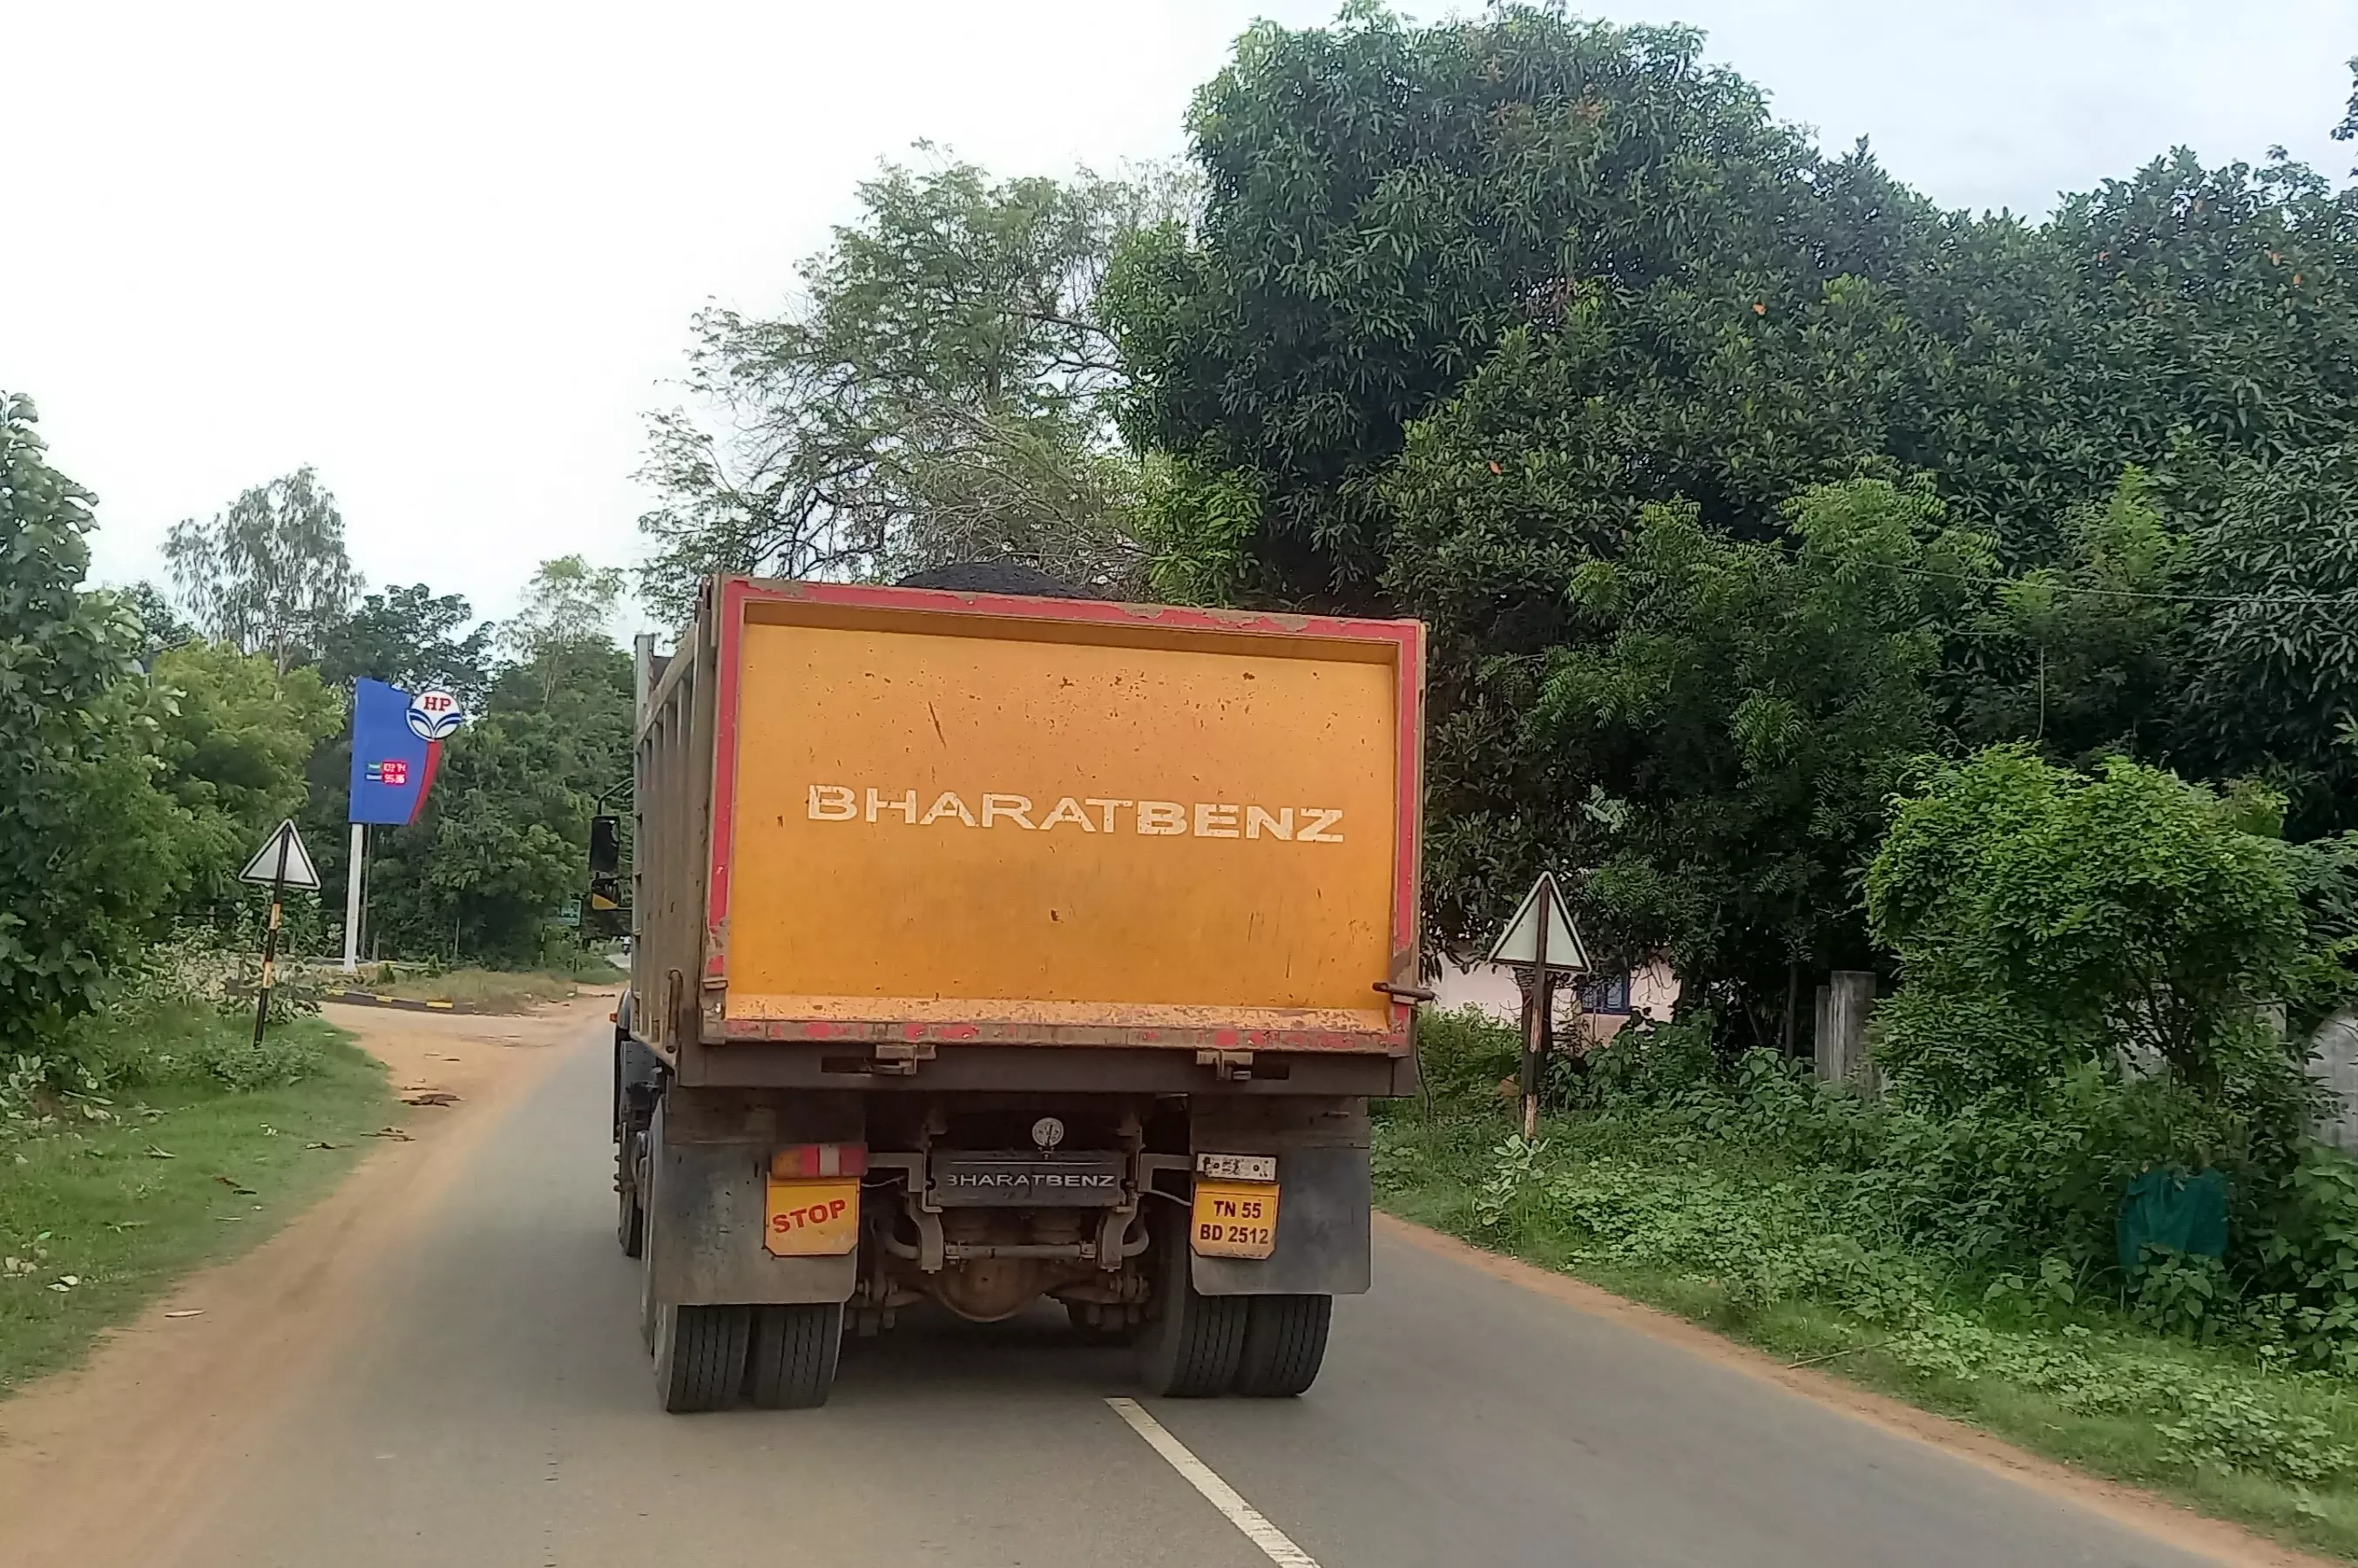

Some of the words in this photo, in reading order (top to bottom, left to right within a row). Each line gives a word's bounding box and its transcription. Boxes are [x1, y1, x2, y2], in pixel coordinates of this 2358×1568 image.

[423, 696, 451, 712] HP
[807, 784, 1345, 843] BHARATBENZ
[772, 1199, 846, 1233] STOP
[1213, 1200, 1237, 1218] TN
[1240, 1201, 1262, 1220] 55
[1199, 1223, 1223, 1241] BD
[1227, 1226, 1269, 1245] 2512
